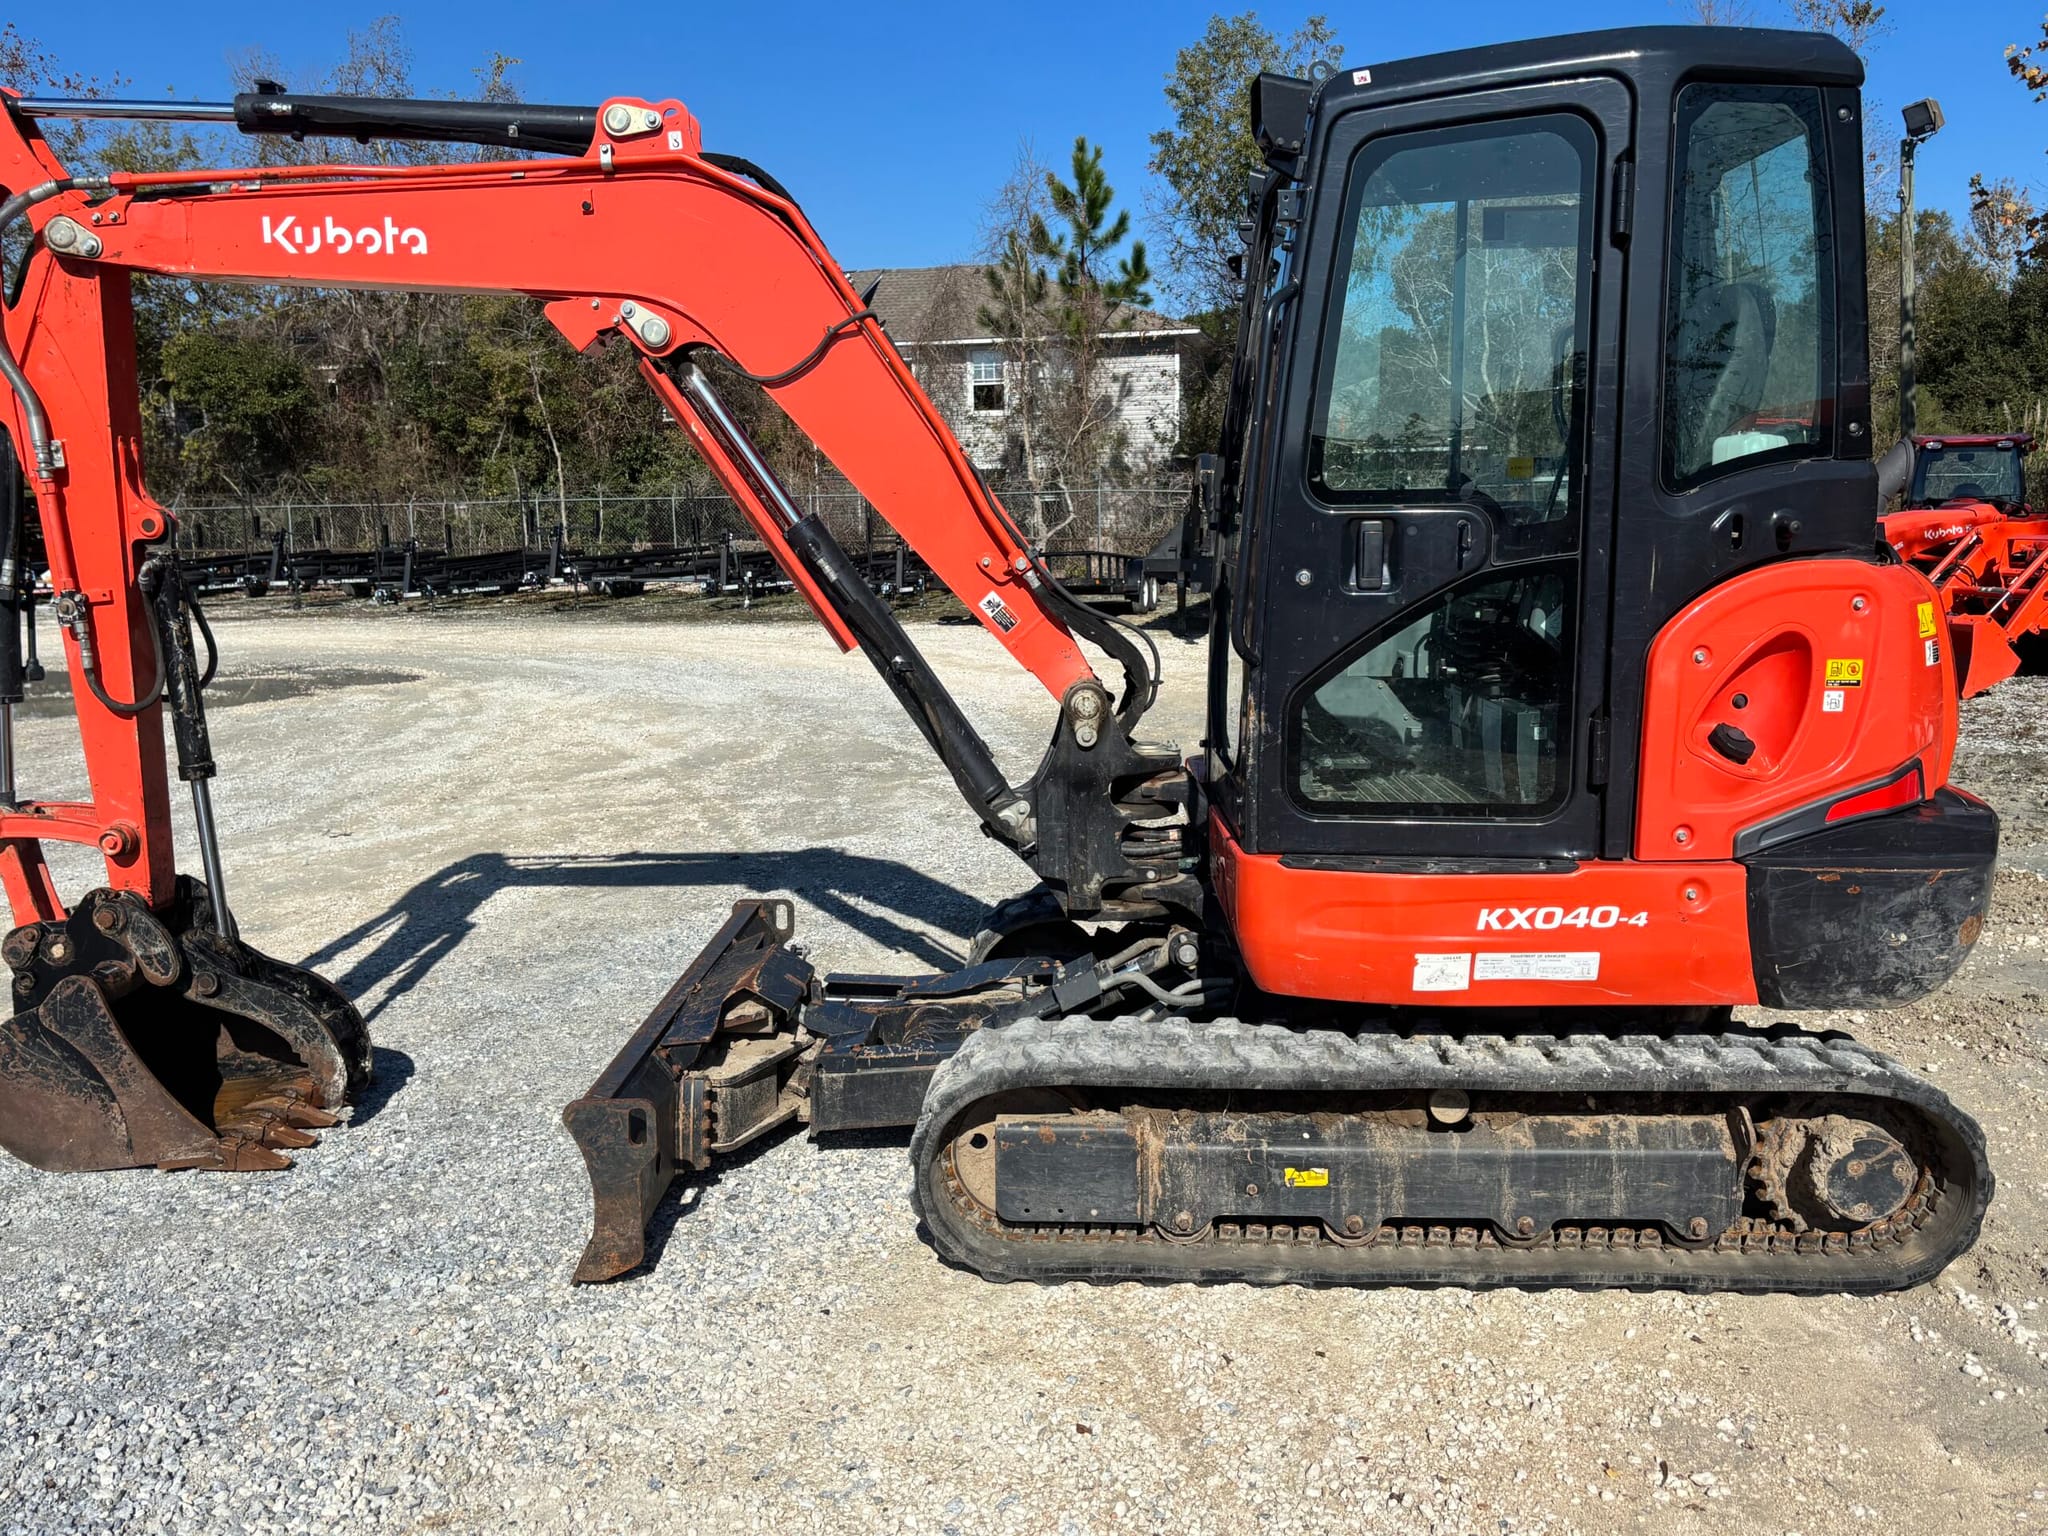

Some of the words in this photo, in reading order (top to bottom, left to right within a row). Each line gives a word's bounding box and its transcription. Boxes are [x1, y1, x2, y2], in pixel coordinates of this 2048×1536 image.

[262, 216, 428, 254] Kubota
[1924, 525, 1963, 539] Kubota
[1476, 906, 1649, 931] KX040-4
